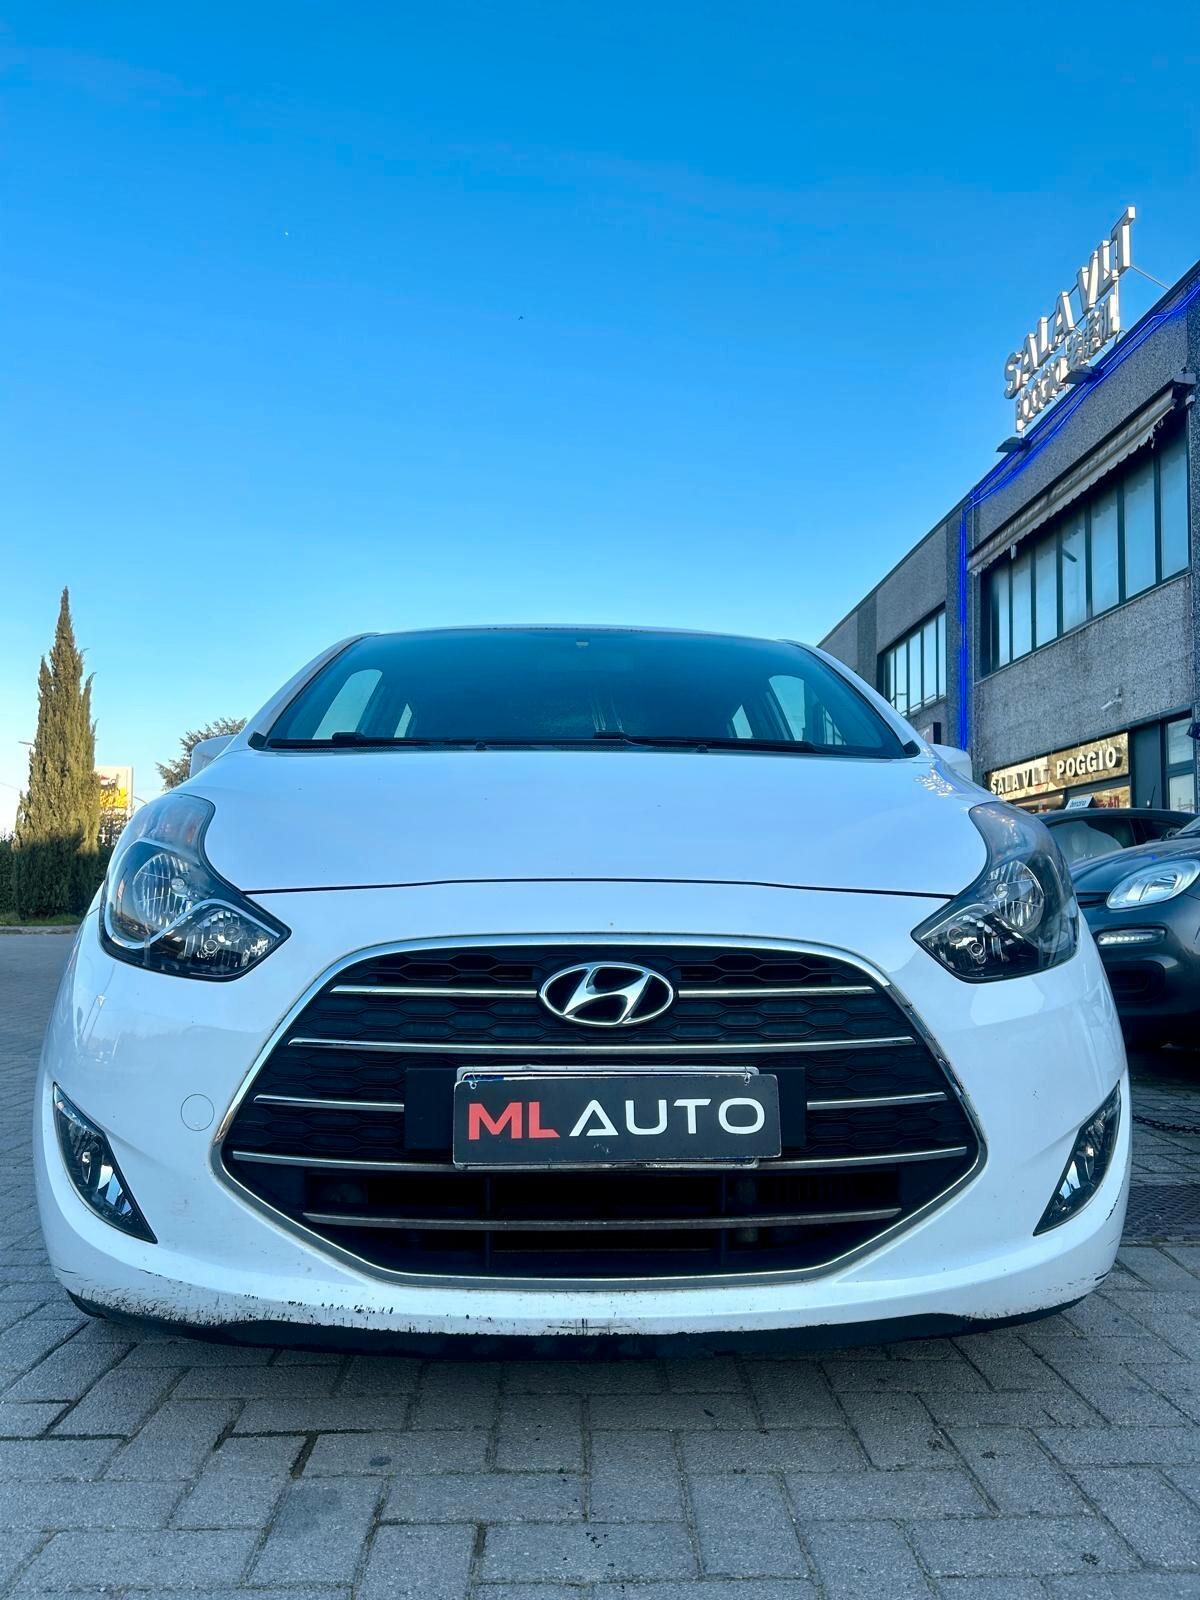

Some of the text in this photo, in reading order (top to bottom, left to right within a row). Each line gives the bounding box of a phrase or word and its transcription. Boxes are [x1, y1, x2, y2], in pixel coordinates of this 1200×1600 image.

[1004, 291, 1076, 400] SALA
[1077, 206, 1136, 315] VLT
[991, 772, 1023, 797] SALA
[1056, 746, 1118, 780] POGGIO
[468, 1097, 765, 1141] ML AUTO
